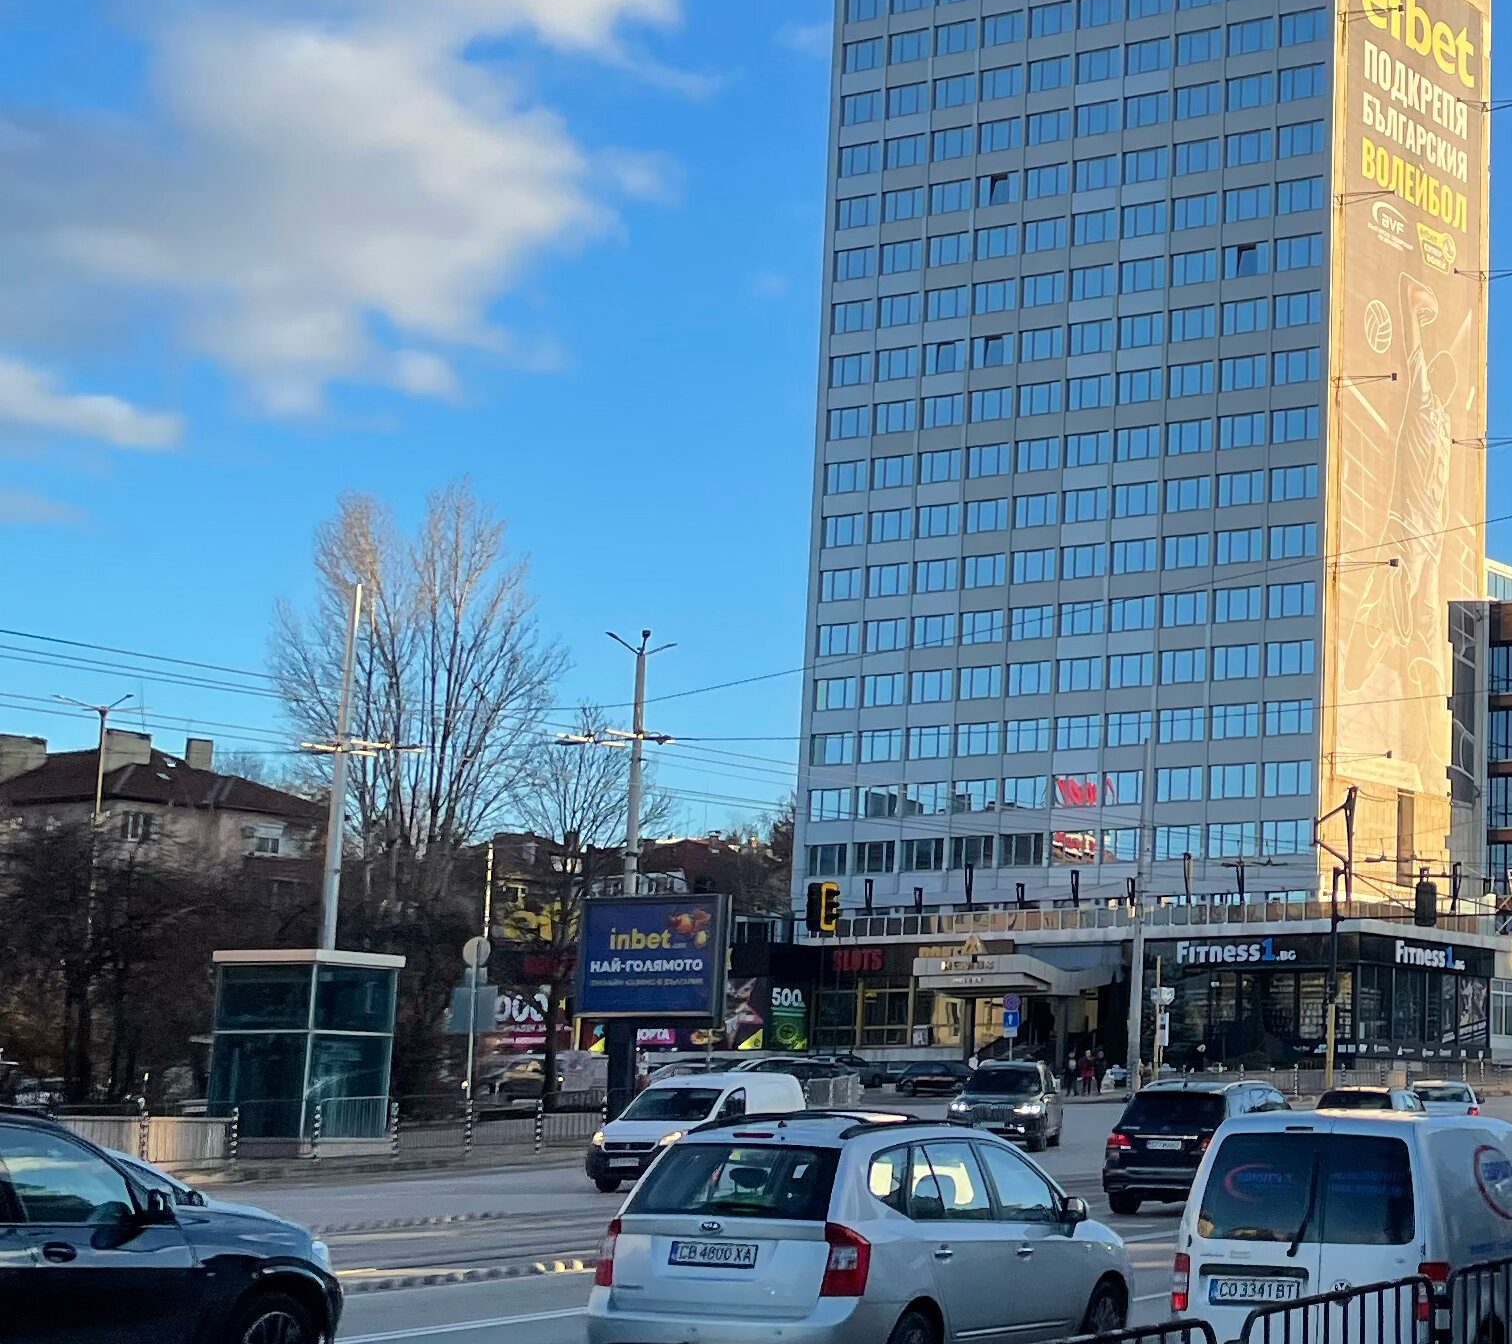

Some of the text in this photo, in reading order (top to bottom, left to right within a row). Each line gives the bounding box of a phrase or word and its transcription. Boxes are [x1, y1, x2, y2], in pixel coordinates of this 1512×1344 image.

[1363, 39, 1468, 141] ПОДКРЕПЯ
[1362, 91, 1468, 183] БЪЛГАРСКИЯ
[1361, 136, 1468, 233] ВОЛЕЙБОЛ
[609, 928, 671, 950] inbet
[590, 958, 703, 973] НАЙ-ГОЛЯМОТО
[834, 949, 883, 972] SLOTS
[1219, 1281, 1238, 1297] CO
[1240, 1281, 1272, 1298] 3341
